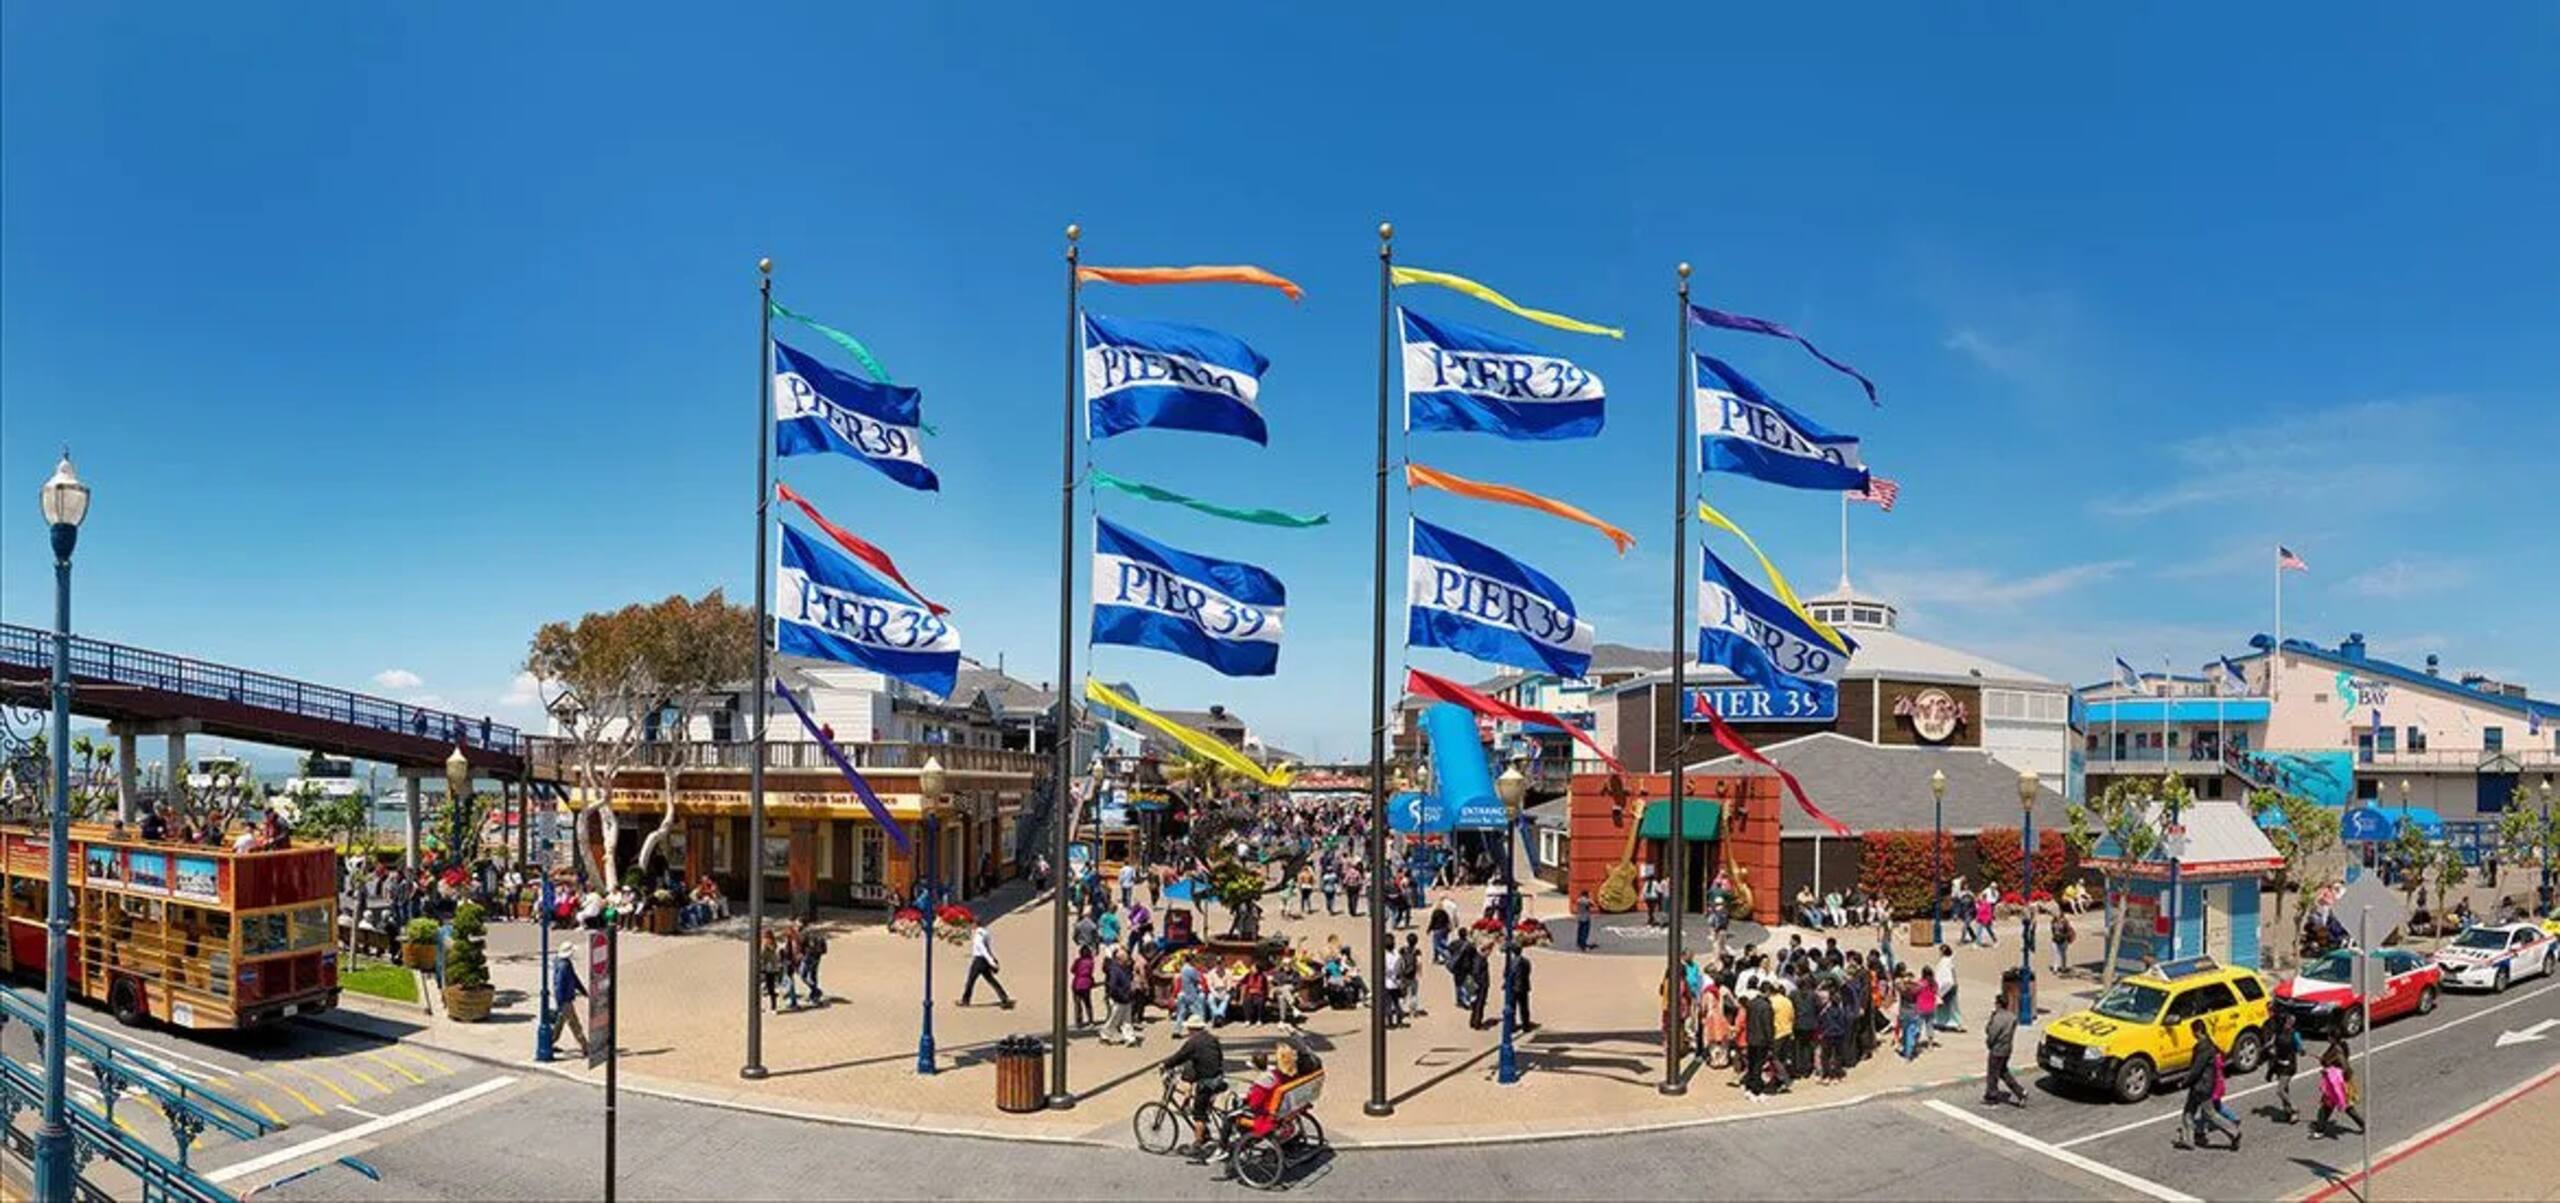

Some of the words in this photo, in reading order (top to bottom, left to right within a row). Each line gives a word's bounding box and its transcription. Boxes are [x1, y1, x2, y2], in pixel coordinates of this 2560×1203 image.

[1430, 347, 1540, 398] PIER
[1540, 361, 1591, 399] 39
[787, 376, 870, 453] PIER
[869, 422, 909, 458] 39
[799, 577, 893, 647] PIER
[895, 610, 948, 649] 39
[1114, 561, 1209, 631] PIER
[1211, 600, 1266, 637] 39
[1433, 566, 1533, 632] PIER
[1533, 601, 1577, 644] 39
[1783, 641, 1831, 676] 39
[1783, 690, 1820, 717] 39
[2359, 690, 2388, 705] BAY
[830, 794, 848, 805] San
